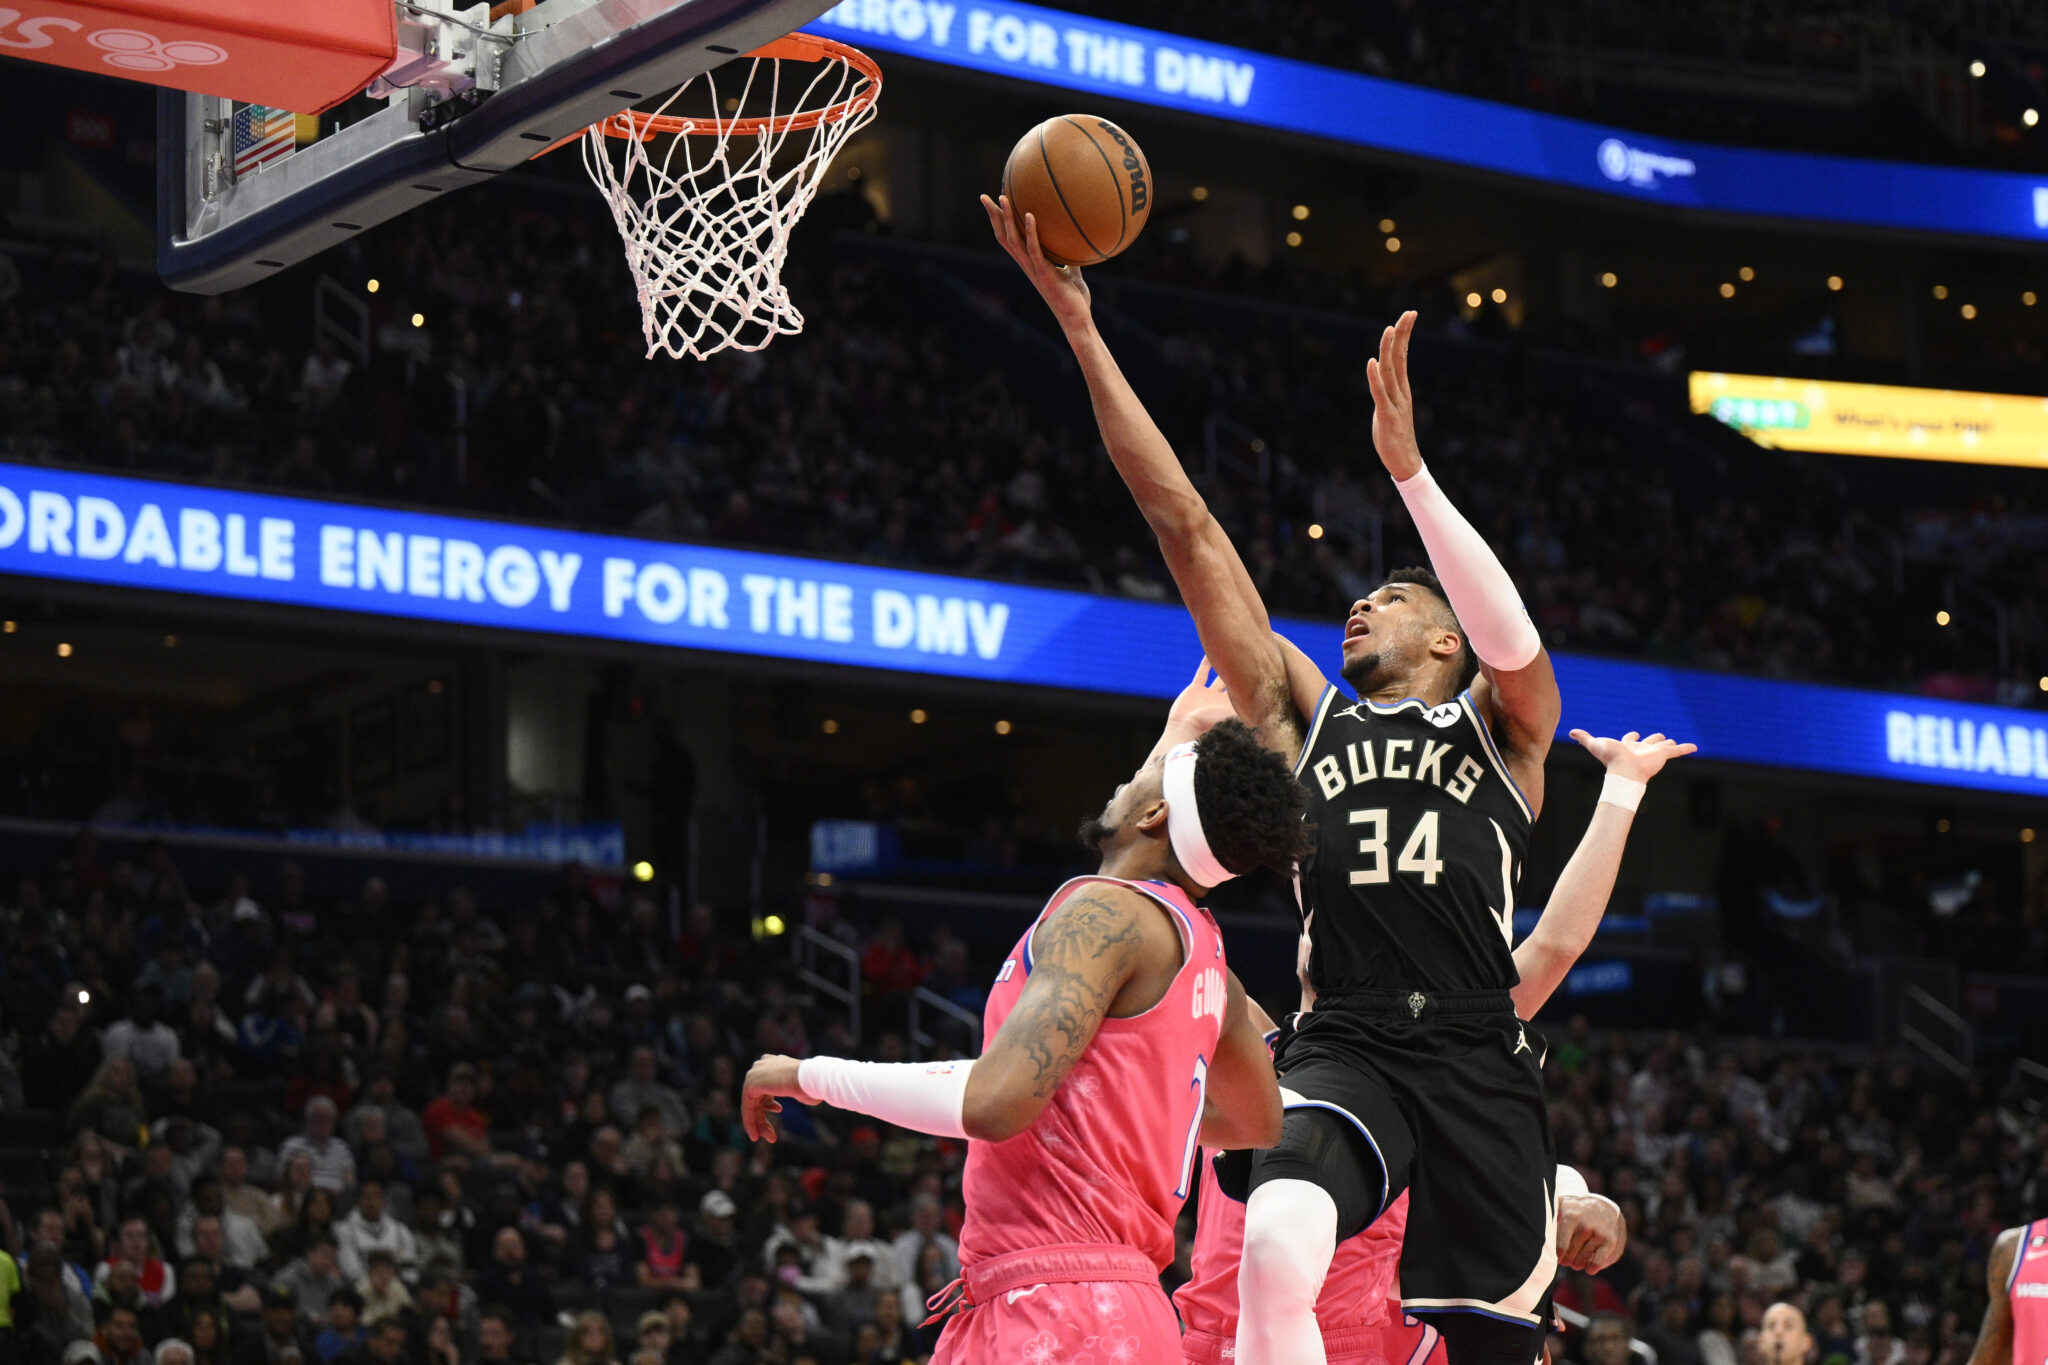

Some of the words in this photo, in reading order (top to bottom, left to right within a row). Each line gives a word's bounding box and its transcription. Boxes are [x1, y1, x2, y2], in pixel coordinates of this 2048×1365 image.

[822, 0, 955, 47] ERGY
[967, 10, 1059, 69] FOR
[1065, 28, 1145, 85] THE
[1154, 48, 1255, 107] DMV
[1097, 121, 1148, 216] Wilson
[320, 525, 582, 612] ENERGY
[603, 557, 729, 629] FOR
[741, 574, 854, 643] THE
[872, 588, 1010, 660] DMV
[1313, 738, 1485, 806] BUCKS
[1886, 710, 2048, 780] RELIABL
[1347, 807, 1444, 886] 34
